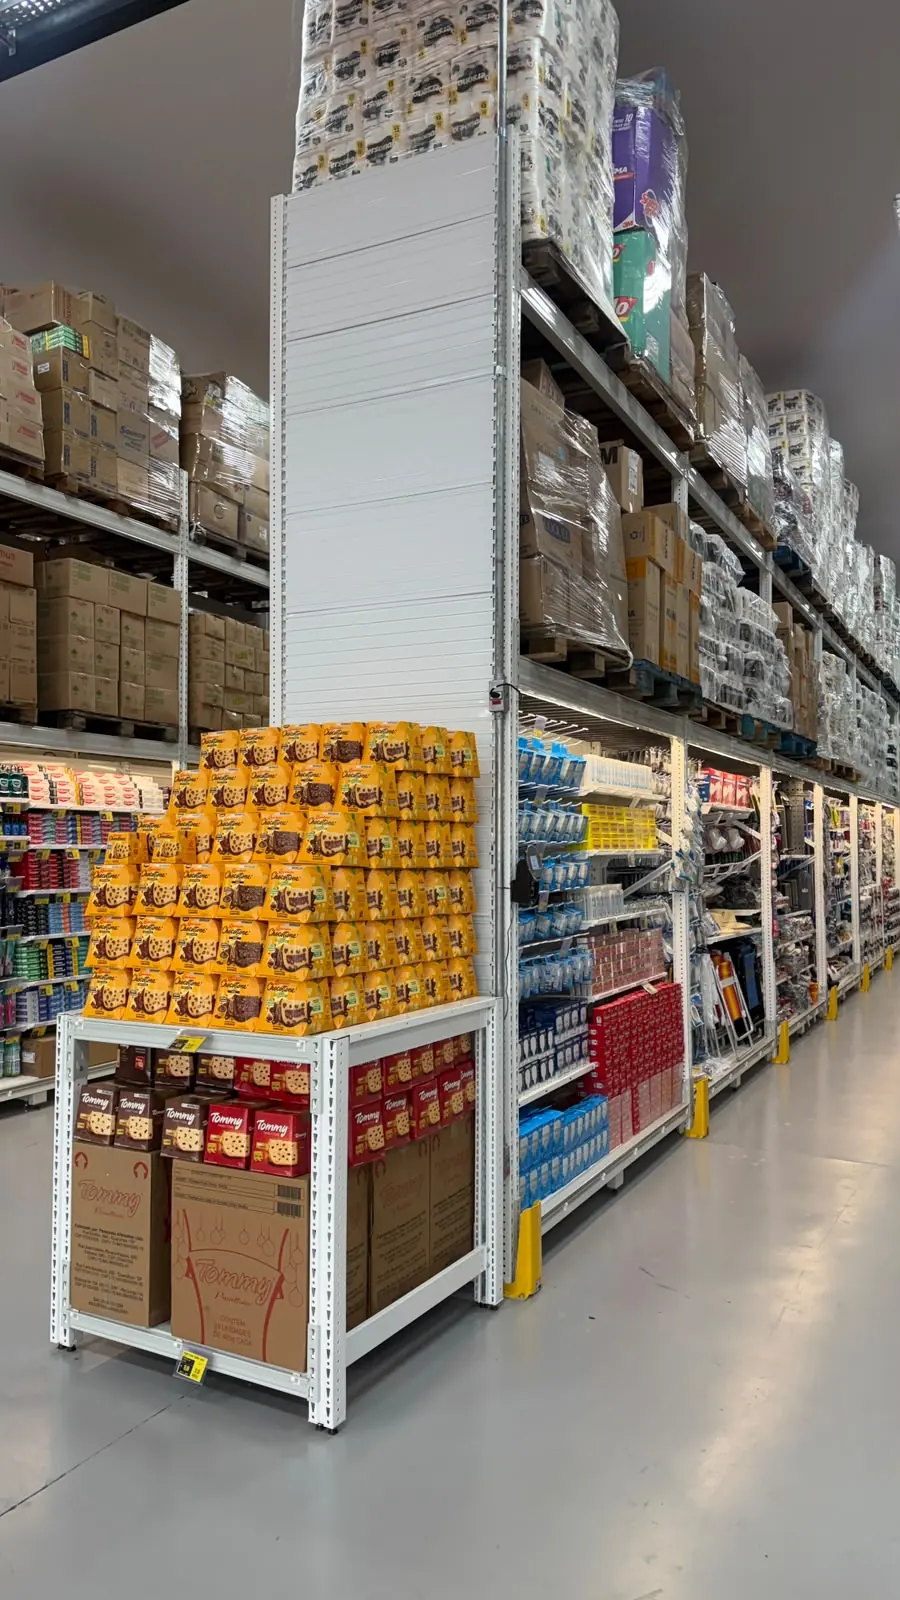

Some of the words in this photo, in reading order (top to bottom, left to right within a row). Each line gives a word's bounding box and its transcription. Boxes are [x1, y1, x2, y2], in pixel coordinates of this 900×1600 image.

[419, 1088, 437, 1101] Tommy
[443, 1080, 461, 1092] Tommy
[81, 1093, 109, 1110] Tommy
[120, 1098, 146, 1114] Tommy
[385, 1098, 406, 1111] Tommy
[166, 1108, 195, 1125] Tommy
[210, 1112, 243, 1130] Tommy
[355, 1111, 380, 1124] Tommy
[256, 1120, 288, 1137] Tommy
[79, 1179, 142, 1218] Tommy
[195, 1259, 273, 1306] Tommy
